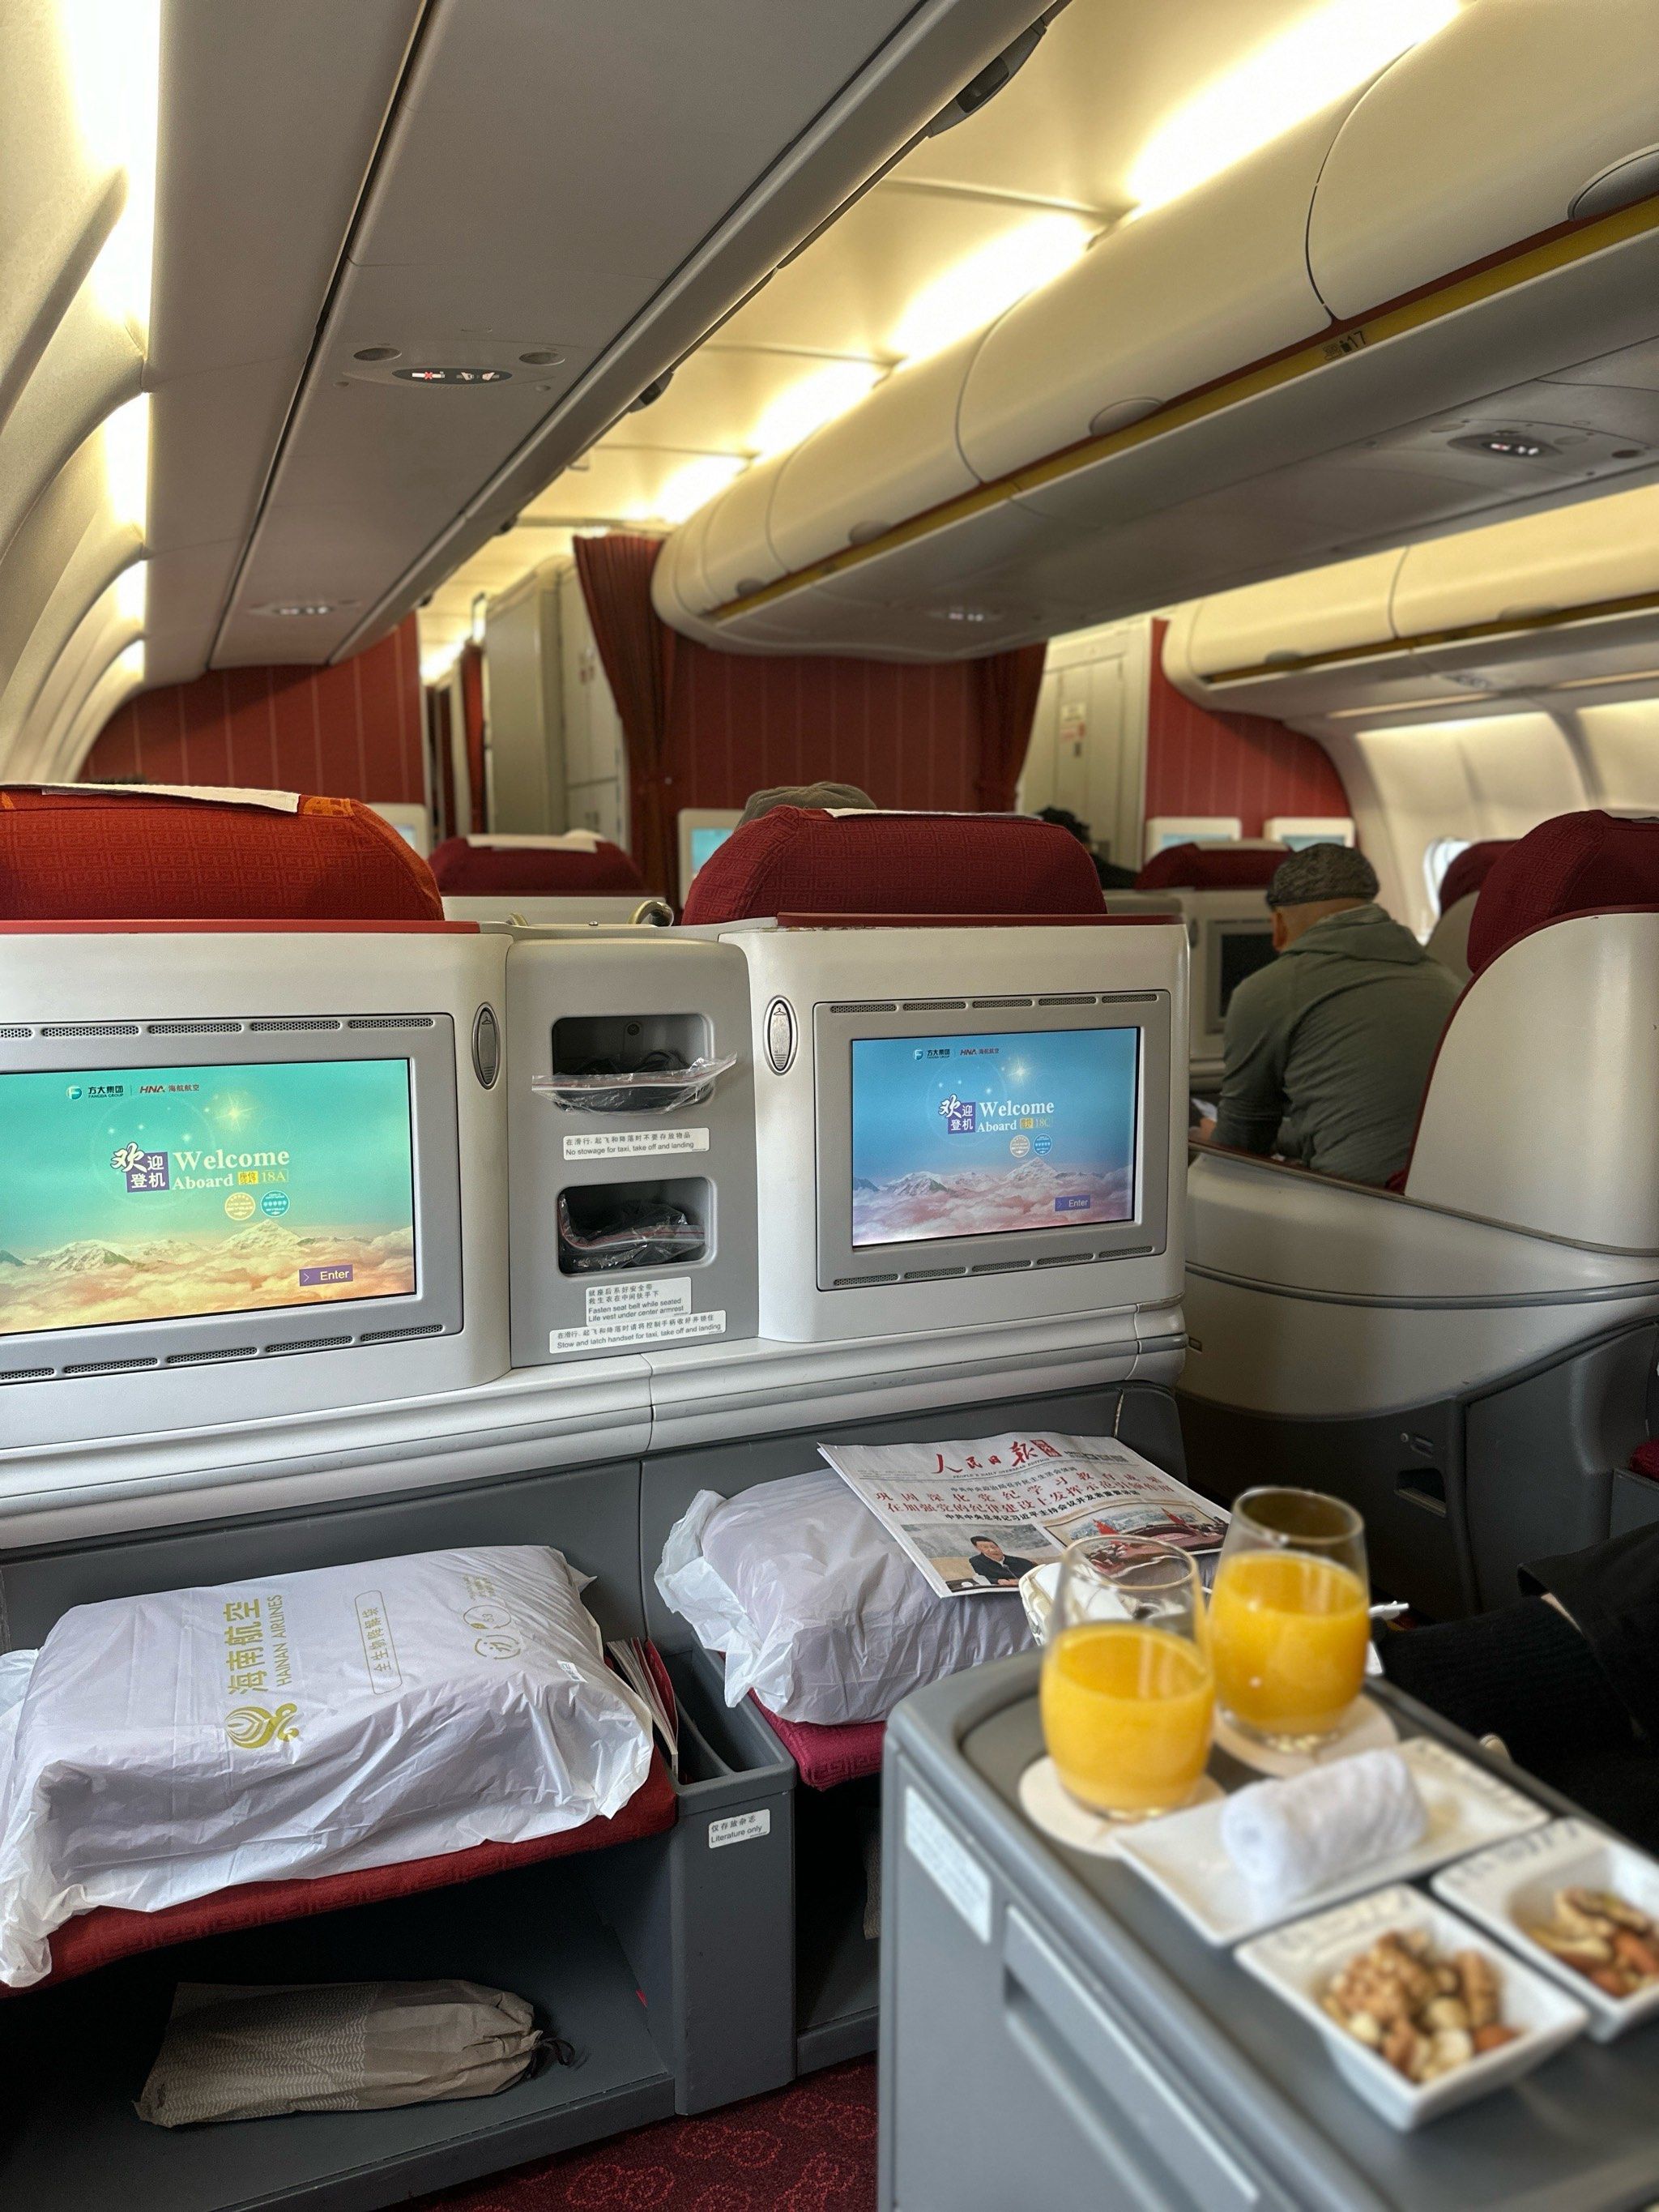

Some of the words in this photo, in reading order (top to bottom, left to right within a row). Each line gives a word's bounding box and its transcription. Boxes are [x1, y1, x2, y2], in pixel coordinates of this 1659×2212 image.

[1347, 331, 1366, 348] 17
[88, 1084, 124, 1095] 方大集团
[139, 1085, 165, 1094] HNA
[168, 1083, 200, 1093] 海航航空
[979, 1100, 1055, 1117] Welcome
[950, 1118, 974, 1131] 登机
[977, 1120, 1017, 1133] Aboard
[566, 1148, 576, 1156] No
[578, 1145, 606, 1155] stowage
[607, 1145, 616, 1153] for
[617, 1144, 631, 1153] taxi,
[633, 1143, 646, 1151] take
[672, 1141, 694, 1151] landing
[173, 1148, 290, 1172] Welcome
[130, 1172, 166, 1189] 登机
[172, 1173, 234, 1190] Aboard
[262, 1171, 286, 1183] 18A
[1068, 1199, 1089, 1207] Enter
[320, 1270, 350, 1281] Enter
[588, 1305, 612, 1314] Fasten
[642, 1300, 659, 1308] while
[660, 1298, 681, 1306] seated
[588, 1313, 601, 1322] Life
[618, 1311, 636, 1319] under
[638, 1309, 658, 1317] center
[659, 1305, 684, 1314] armrest
[557, 1341, 574, 1349] Stow
[591, 1337, 607, 1345] latch
[608, 1334, 634, 1343] handset
[661, 1329, 675, 1337] take
[699, 1323, 721, 1333] landing
[267, 1594, 287, 1638] AIRLINES
[223, 1598, 269, 1695] 海南航空
[272, 1642, 292, 1687] HAINAN
[710, 1830, 746, 1843] Literature
[747, 1825, 762, 1834] only
